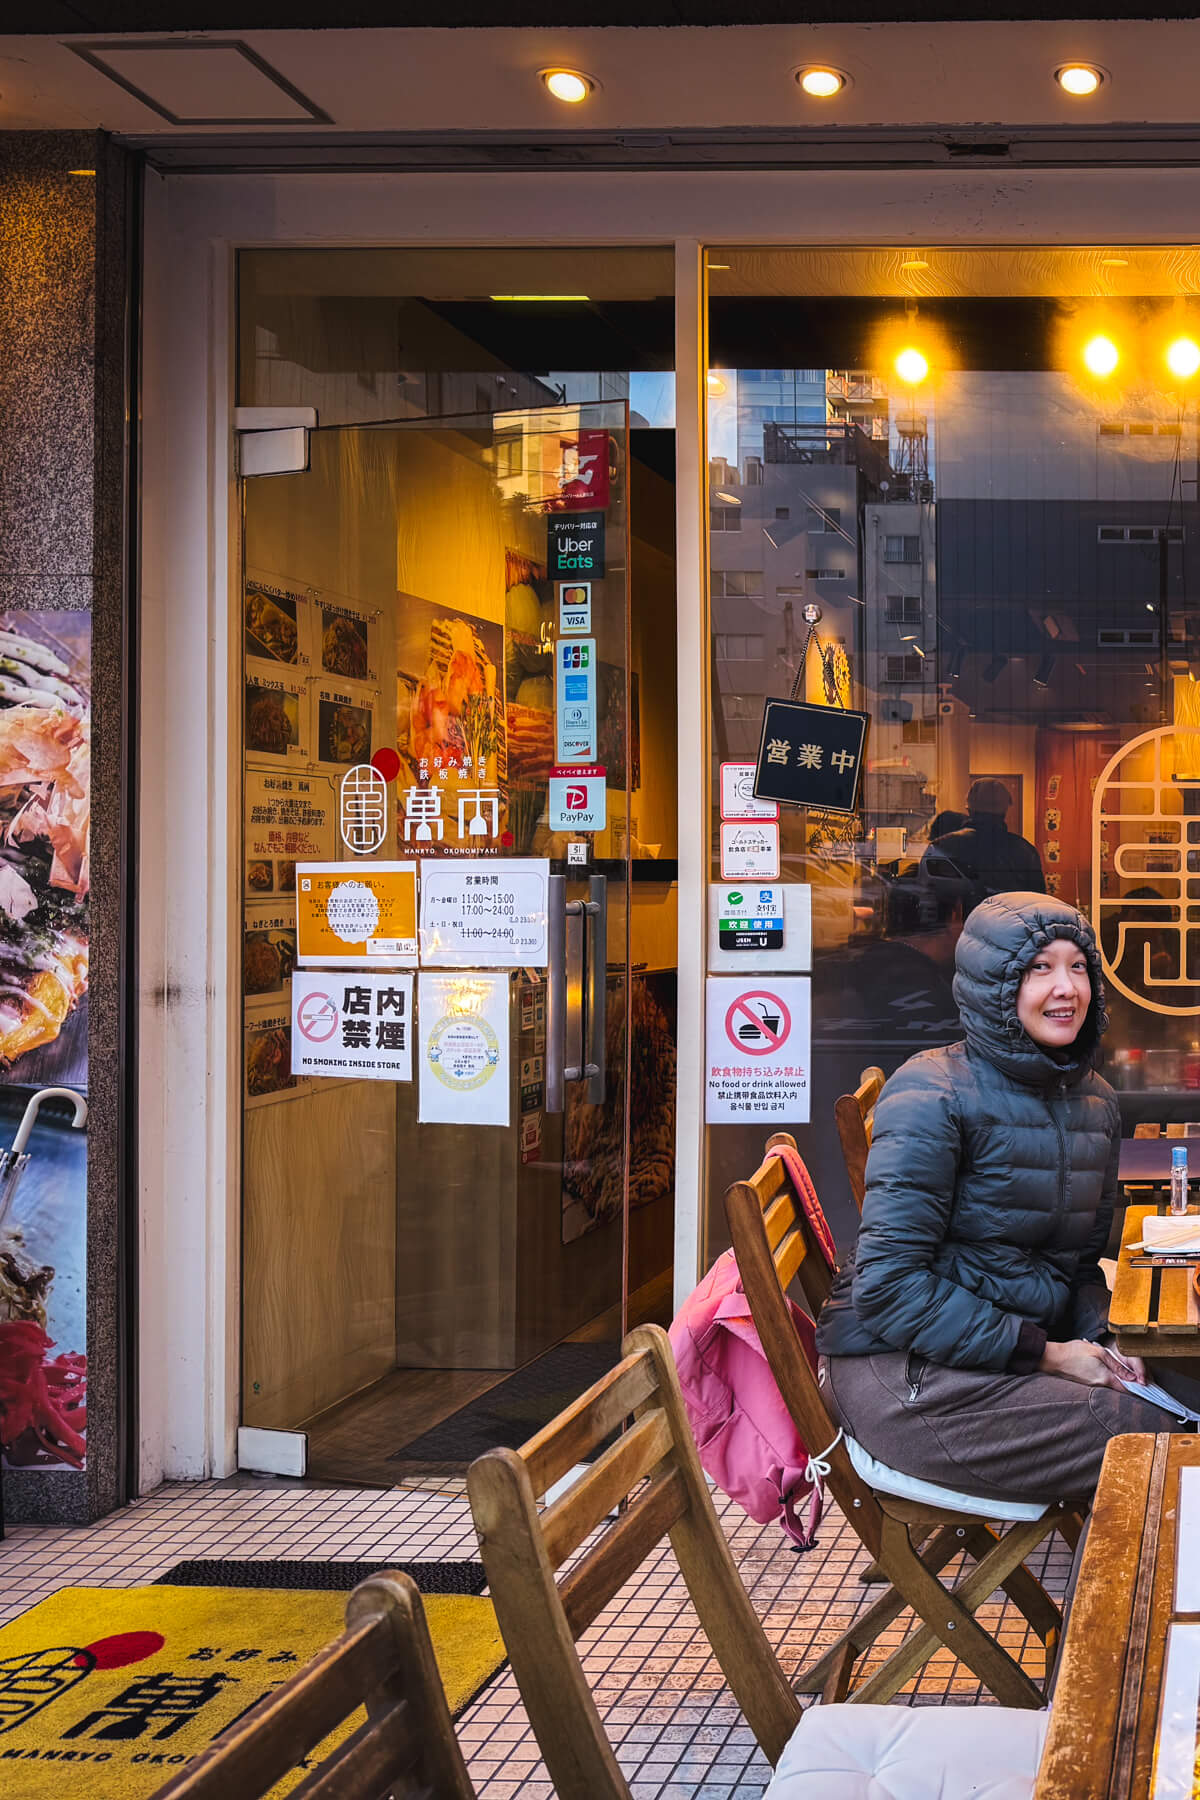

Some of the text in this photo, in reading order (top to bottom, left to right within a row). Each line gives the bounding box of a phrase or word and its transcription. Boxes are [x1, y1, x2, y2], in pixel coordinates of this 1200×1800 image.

[558, 537, 594, 552] Uber
[558, 554, 594, 569] Eats
[566, 616, 586, 625] VISA
[562, 652, 588, 662] JCB
[765, 737, 856, 775] 営業中
[420, 756, 488, 768] お好み焼き
[419, 768, 487, 780] 鉄板焼き
[560, 812, 595, 823] PayPay
[404, 847, 499, 855] MANRYO OKONOMIYAKI
[465, 875, 499, 886] 営業時間
[342, 985, 405, 1017] 店内
[342, 1019, 405, 1051] 禁煙
[302, 1057, 401, 1070] NO SMOKING INSIDE STORE
[711, 1066, 806, 1077] 飲食物持ち込み禁止
[709, 1080, 720, 1088] No
[721, 1080, 740, 1088] food
[752, 1080, 773, 1088] drink
[774, 1080, 807, 1088] allowed
[730, 1102, 785, 1111] 음식물 반입 금지
